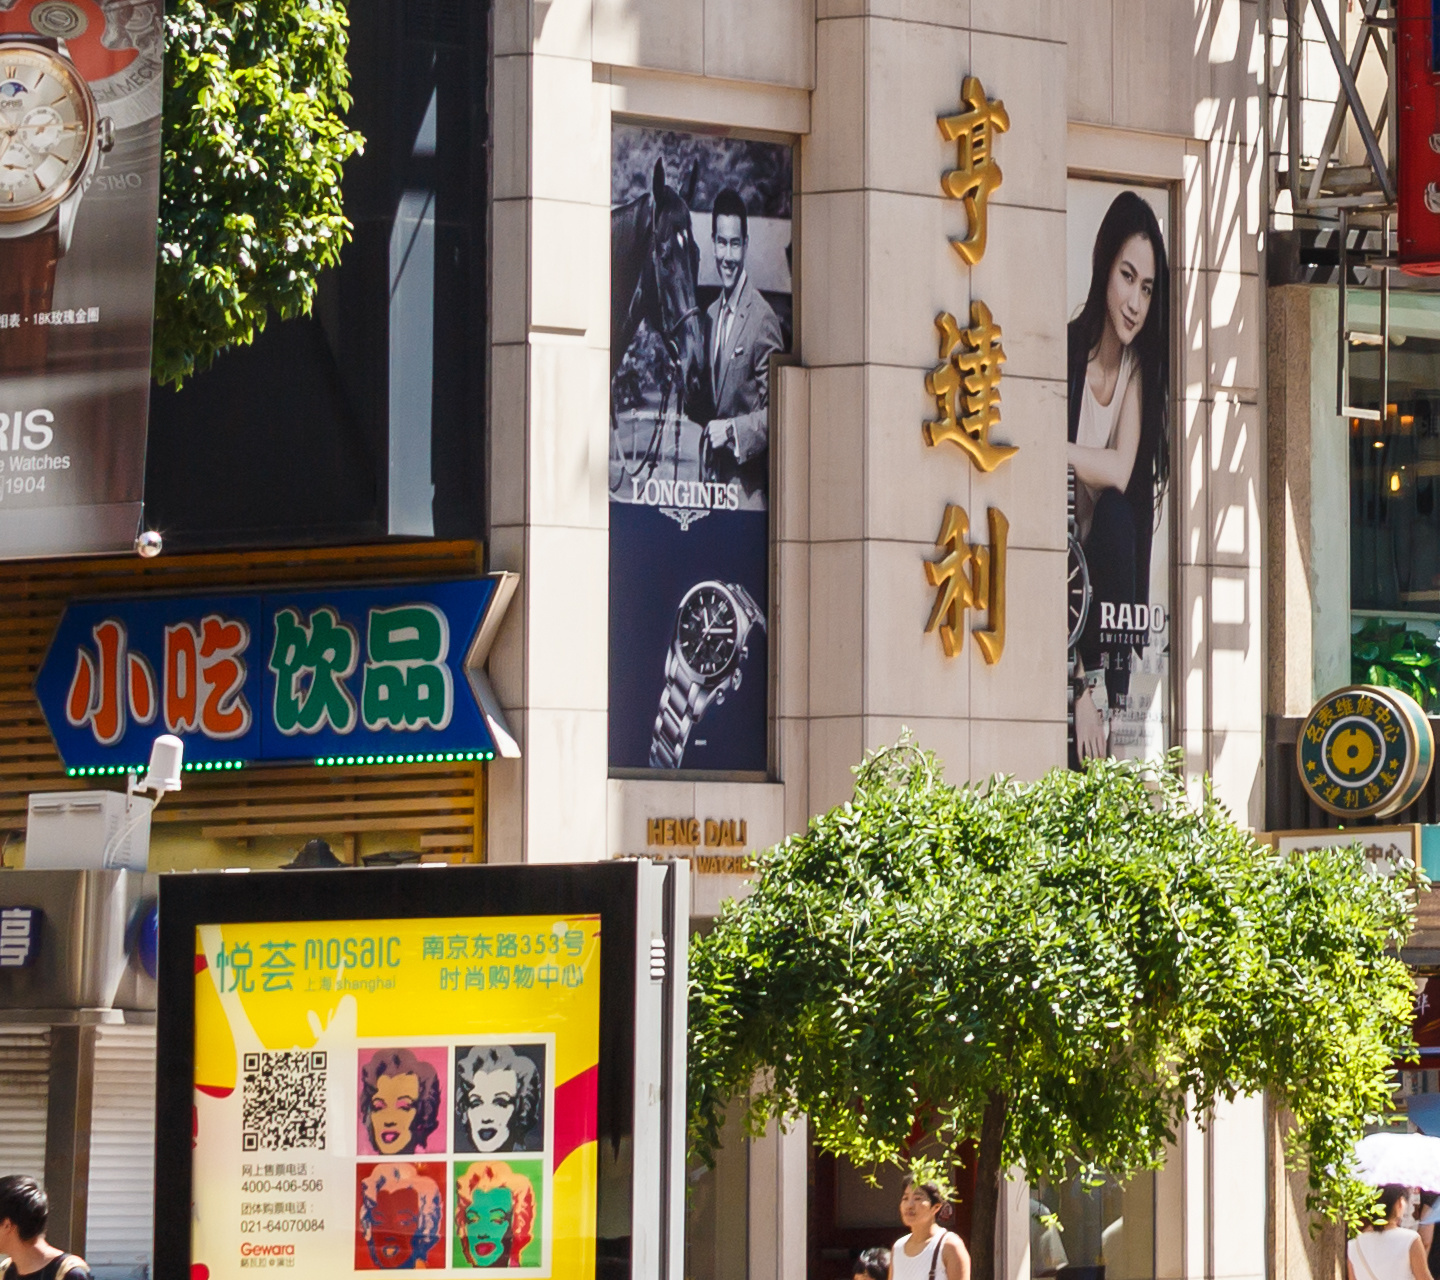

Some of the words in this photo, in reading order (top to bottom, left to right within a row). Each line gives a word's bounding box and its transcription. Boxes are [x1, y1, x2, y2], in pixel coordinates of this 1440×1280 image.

[6, 476, 46, 494] 1904
[631, 477, 739, 510] LONGINES
[1100, 602, 1165, 632] RADO
[647, 817, 700, 846] HENG
[704, 818, 747, 846] DALI
[422, 930, 585, 960] 南京东路353号
[217, 940, 296, 993] 悦荟
[440, 964, 583, 991] 时尚购物中心
[241, 1179, 324, 1192] 4000-406-506
[241, 1219, 325, 1233] 021-64070084
[241, 1242, 295, 1256] Gewara
